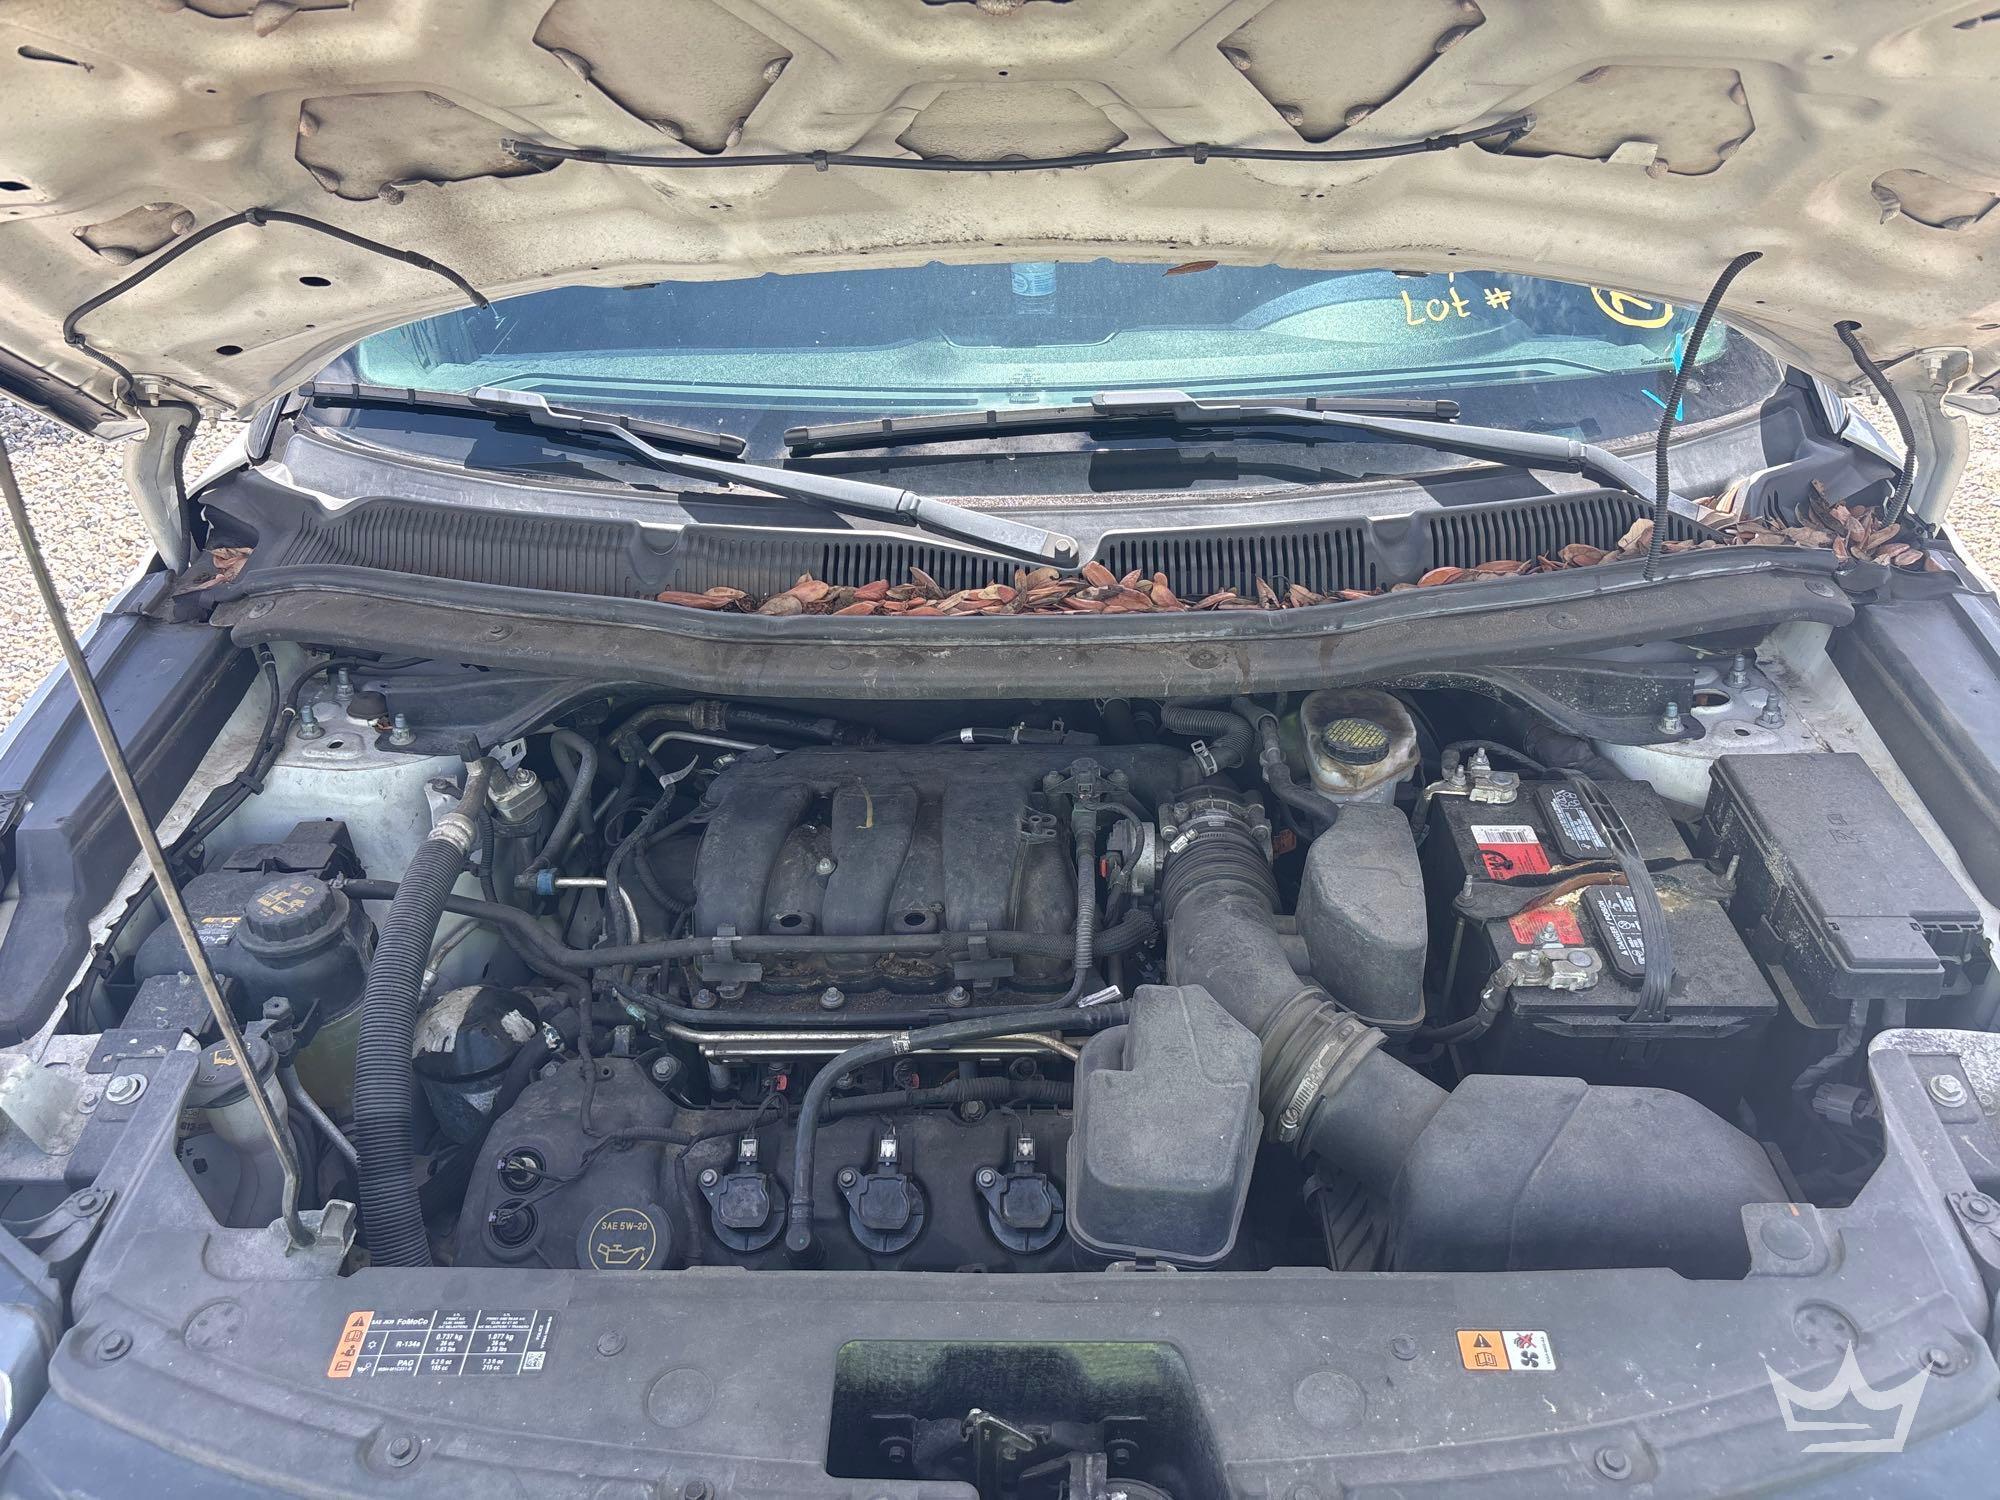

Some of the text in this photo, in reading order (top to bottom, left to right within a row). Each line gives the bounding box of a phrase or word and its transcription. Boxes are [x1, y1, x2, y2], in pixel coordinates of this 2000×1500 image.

[1400, 287, 1512, 326] Lot #
[1597, 900, 1612, 921] POISON
[1609, 925, 1626, 950] DANGER
[601, 1222, 648, 1230] SAE 5W-20
[395, 1340, 421, 1348] R-134a
